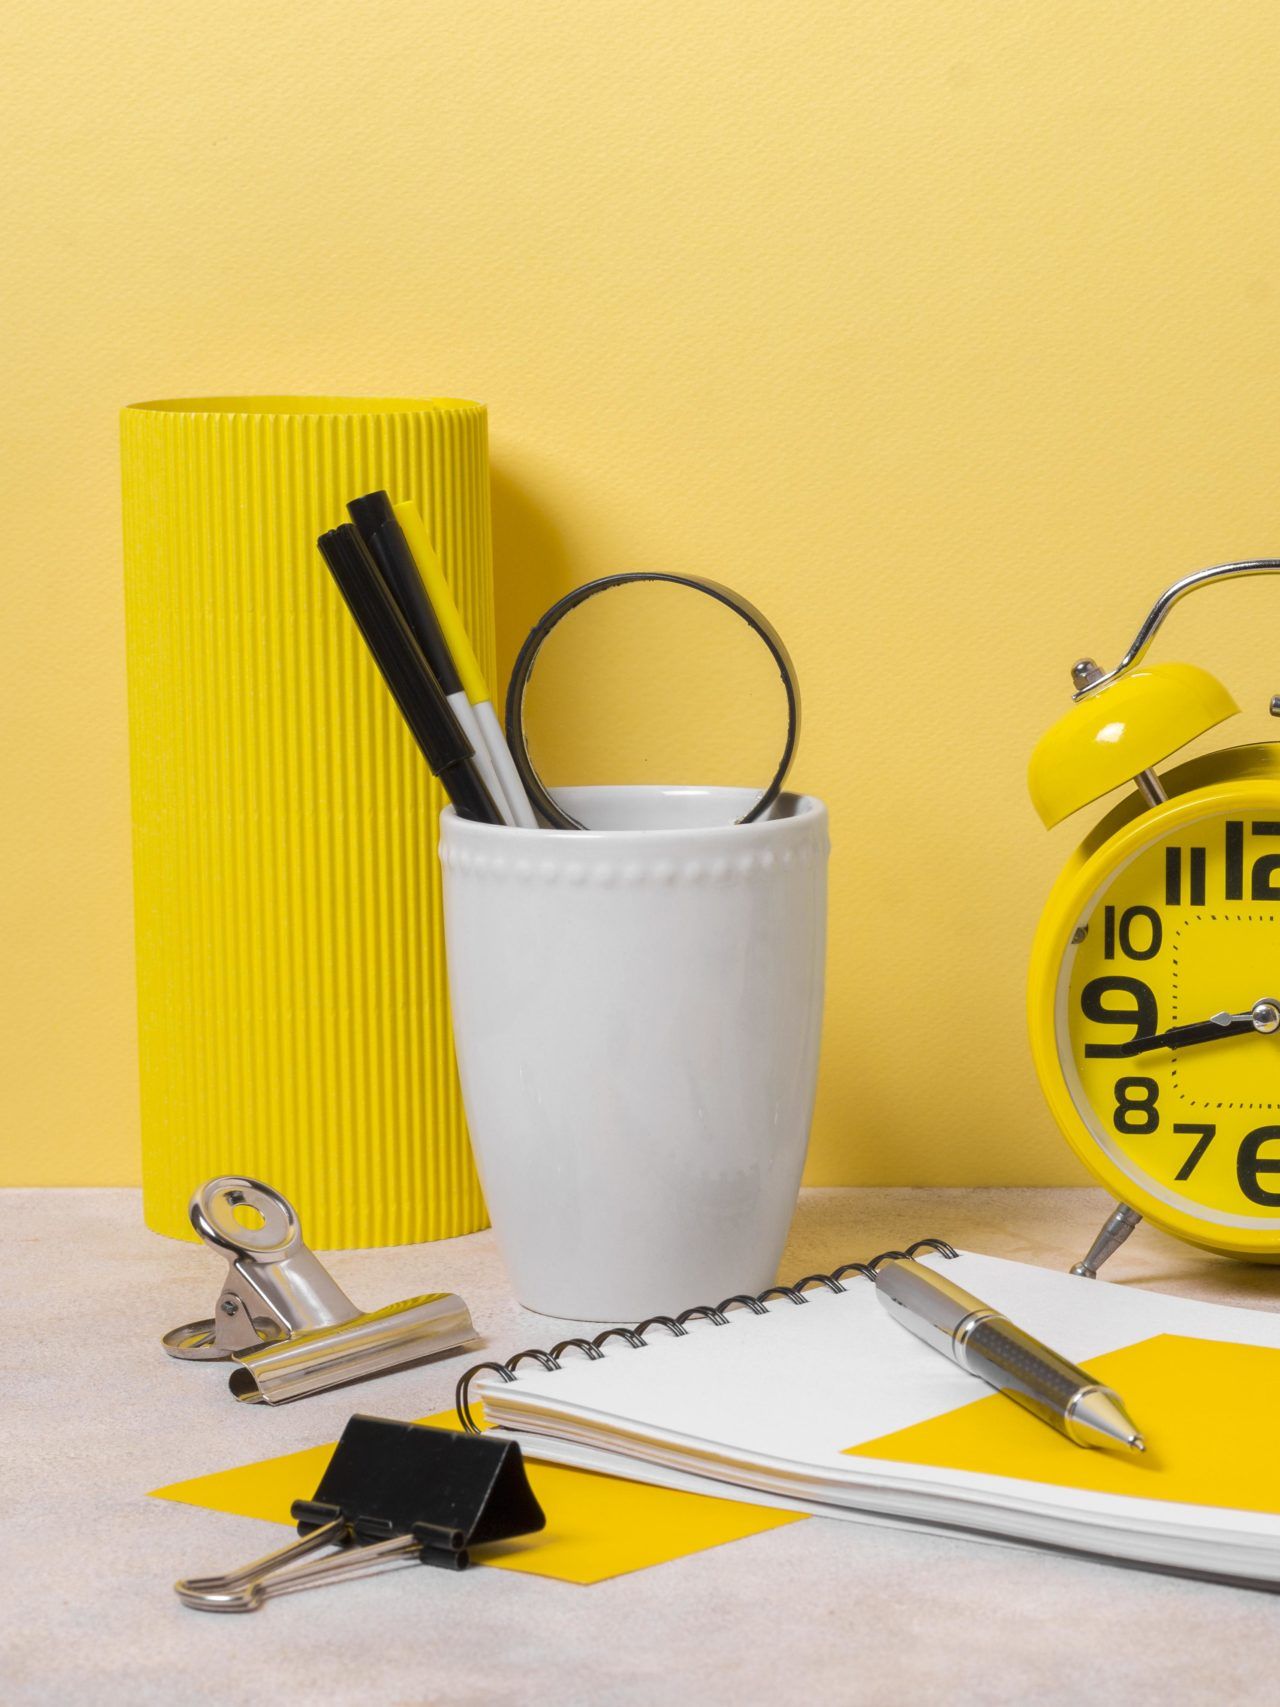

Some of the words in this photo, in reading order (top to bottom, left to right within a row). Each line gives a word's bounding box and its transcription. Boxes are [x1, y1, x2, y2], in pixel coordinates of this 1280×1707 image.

[1165, 847, 1206, 906] 11
[1104, 905, 1163, 961] 10
[1080, 975, 1159, 1059] 9
[1113, 1076, 1160, 1135] 8
[1173, 1123, 1216, 1181] 7
